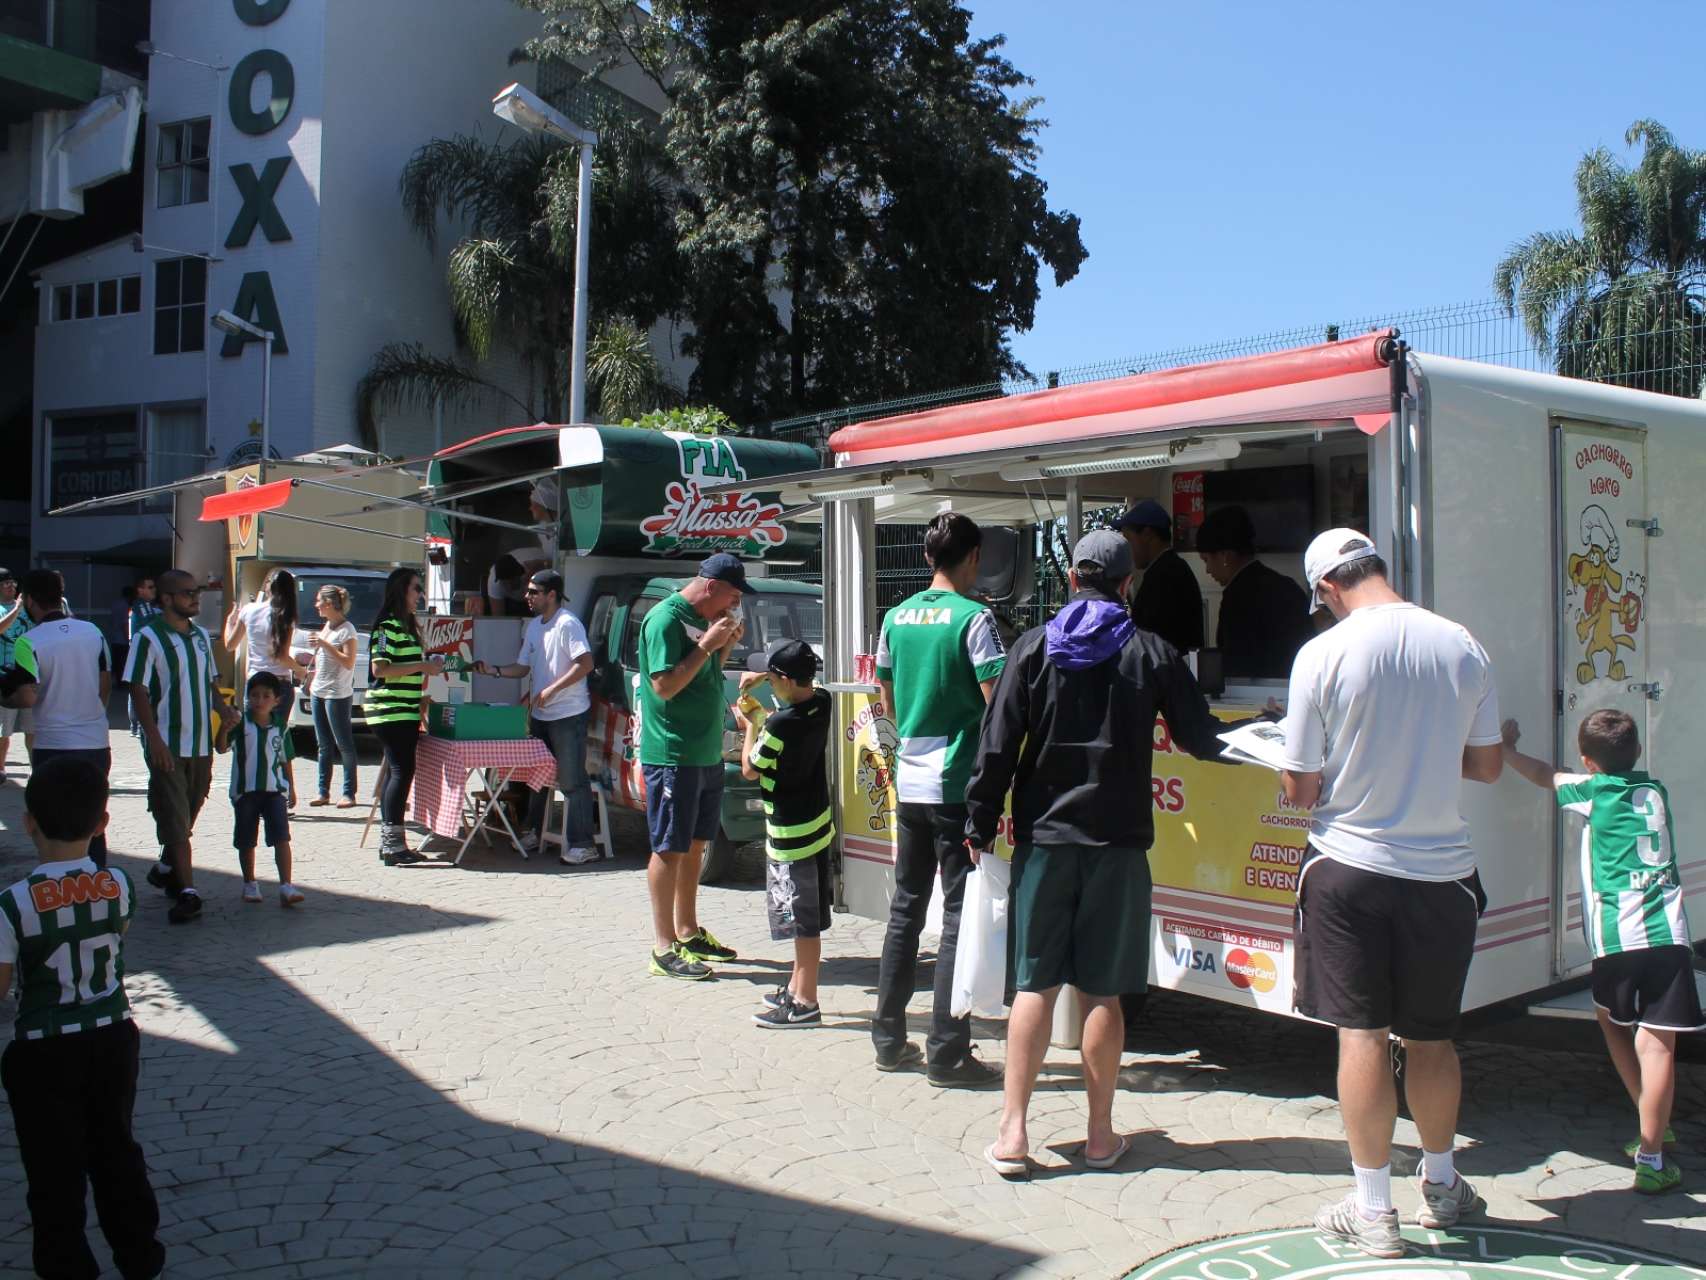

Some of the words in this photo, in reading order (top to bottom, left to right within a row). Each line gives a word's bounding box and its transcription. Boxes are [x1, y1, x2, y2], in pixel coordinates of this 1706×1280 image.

[1576, 444, 1633, 480] CACHORRO
[57, 470, 136, 494] CORITIBA
[1589, 477, 1620, 498] LOKO
[661, 496, 758, 534] Massa
[674, 536, 706, 550] Food
[709, 535, 746, 549] Truck
[894, 608, 952, 625] CAIXA
[1631, 787, 1672, 867] 3
[1246, 867, 1256, 886] E
[31, 870, 121, 913] BMG
[1165, 923, 1206, 938] ACEITAMOS
[1208, 930, 1238, 944] CARTÃO
[1240, 937, 1251, 946] DE
[1252, 936, 1281, 951] DÉBITO
[44, 932, 122, 1005] 10
[1172, 947, 1216, 974] VISA
[1226, 962, 1276, 979] MasterCard
